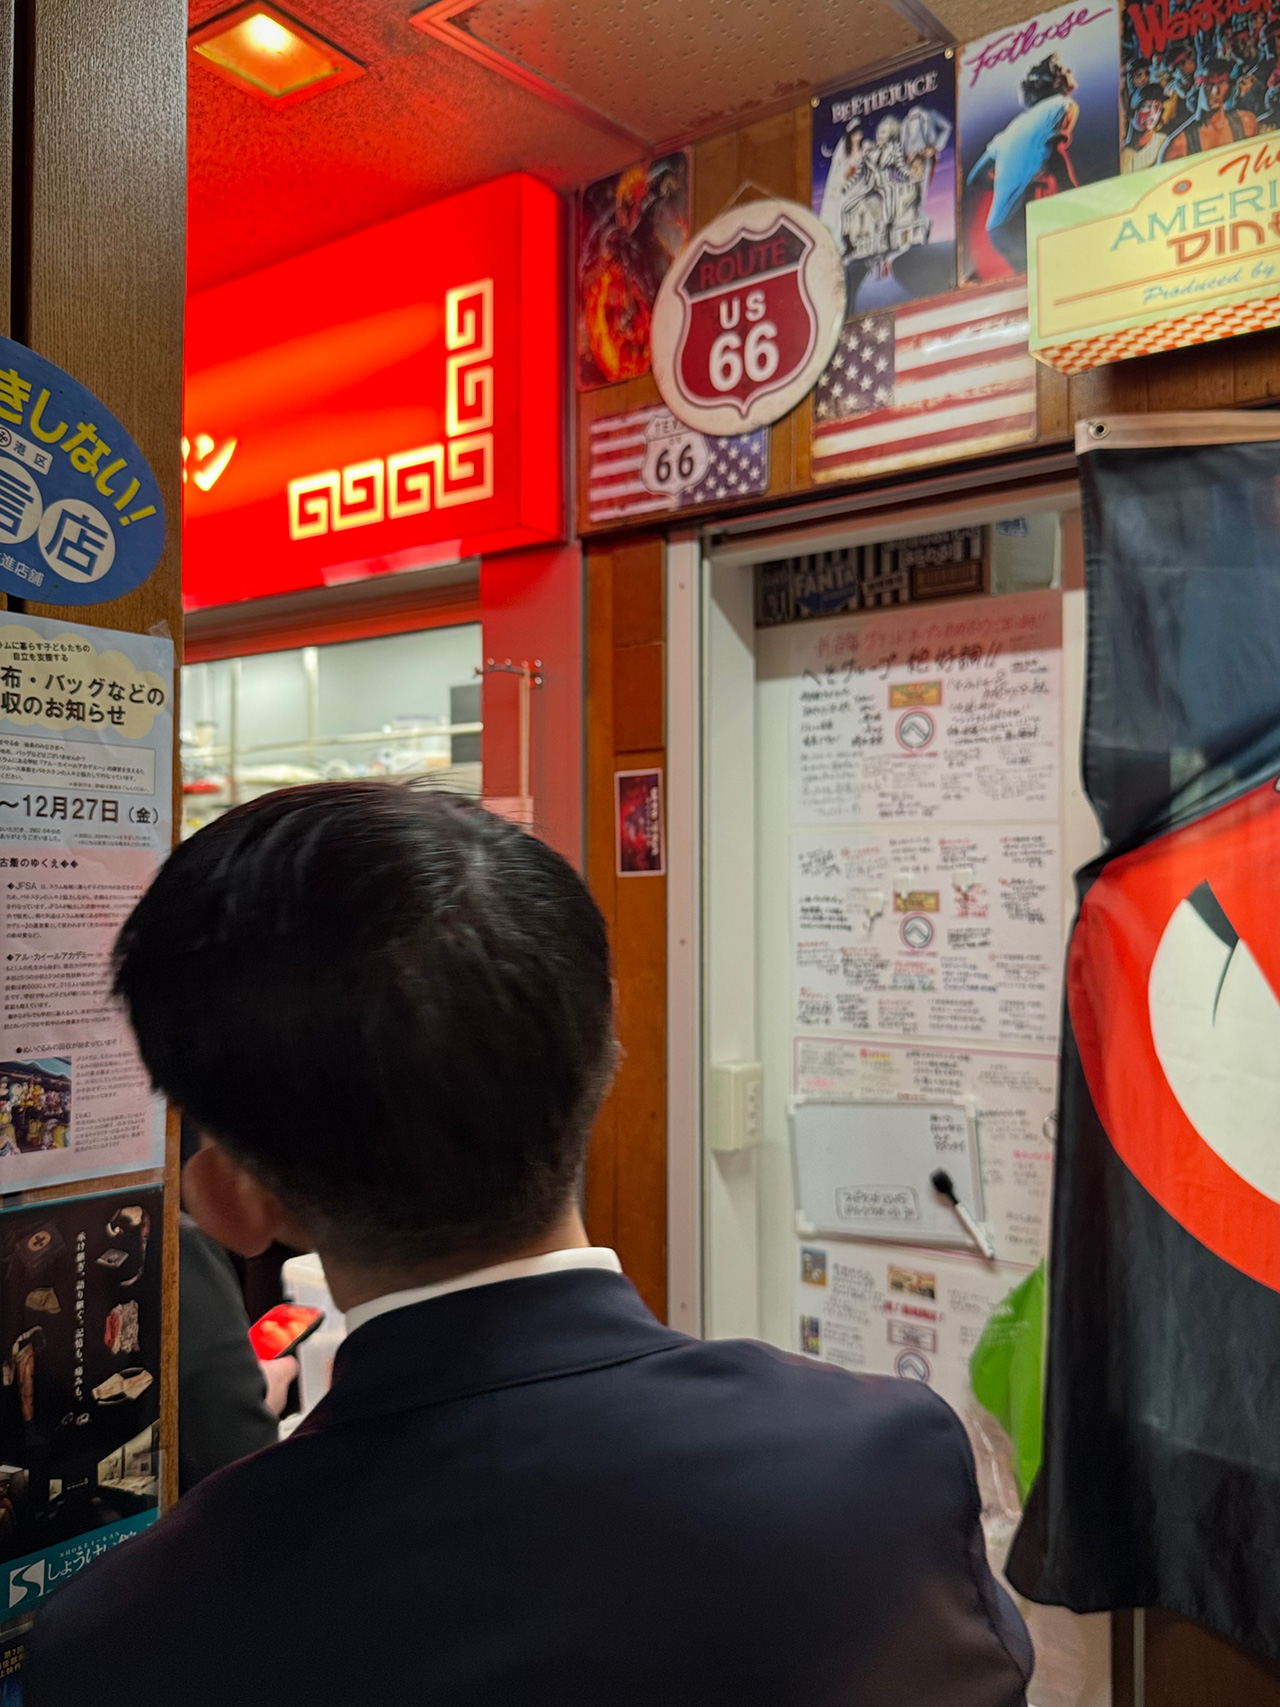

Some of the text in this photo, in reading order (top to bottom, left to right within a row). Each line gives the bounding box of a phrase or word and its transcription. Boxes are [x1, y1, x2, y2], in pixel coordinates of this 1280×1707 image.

[963, 8, 1114, 87] Footloose
[832, 70, 939, 124] BEETLEJUICE
[700, 236, 788, 288] ROUTE
[1142, 258, 1276, 305] Produced by
[719, 291, 766, 330] US
[708, 321, 780, 392] 66
[656, 443, 694, 483] 66
[0, 665, 165, 707] 布・バッグなどの
[1, 691, 126, 726] 収のお知らせ
